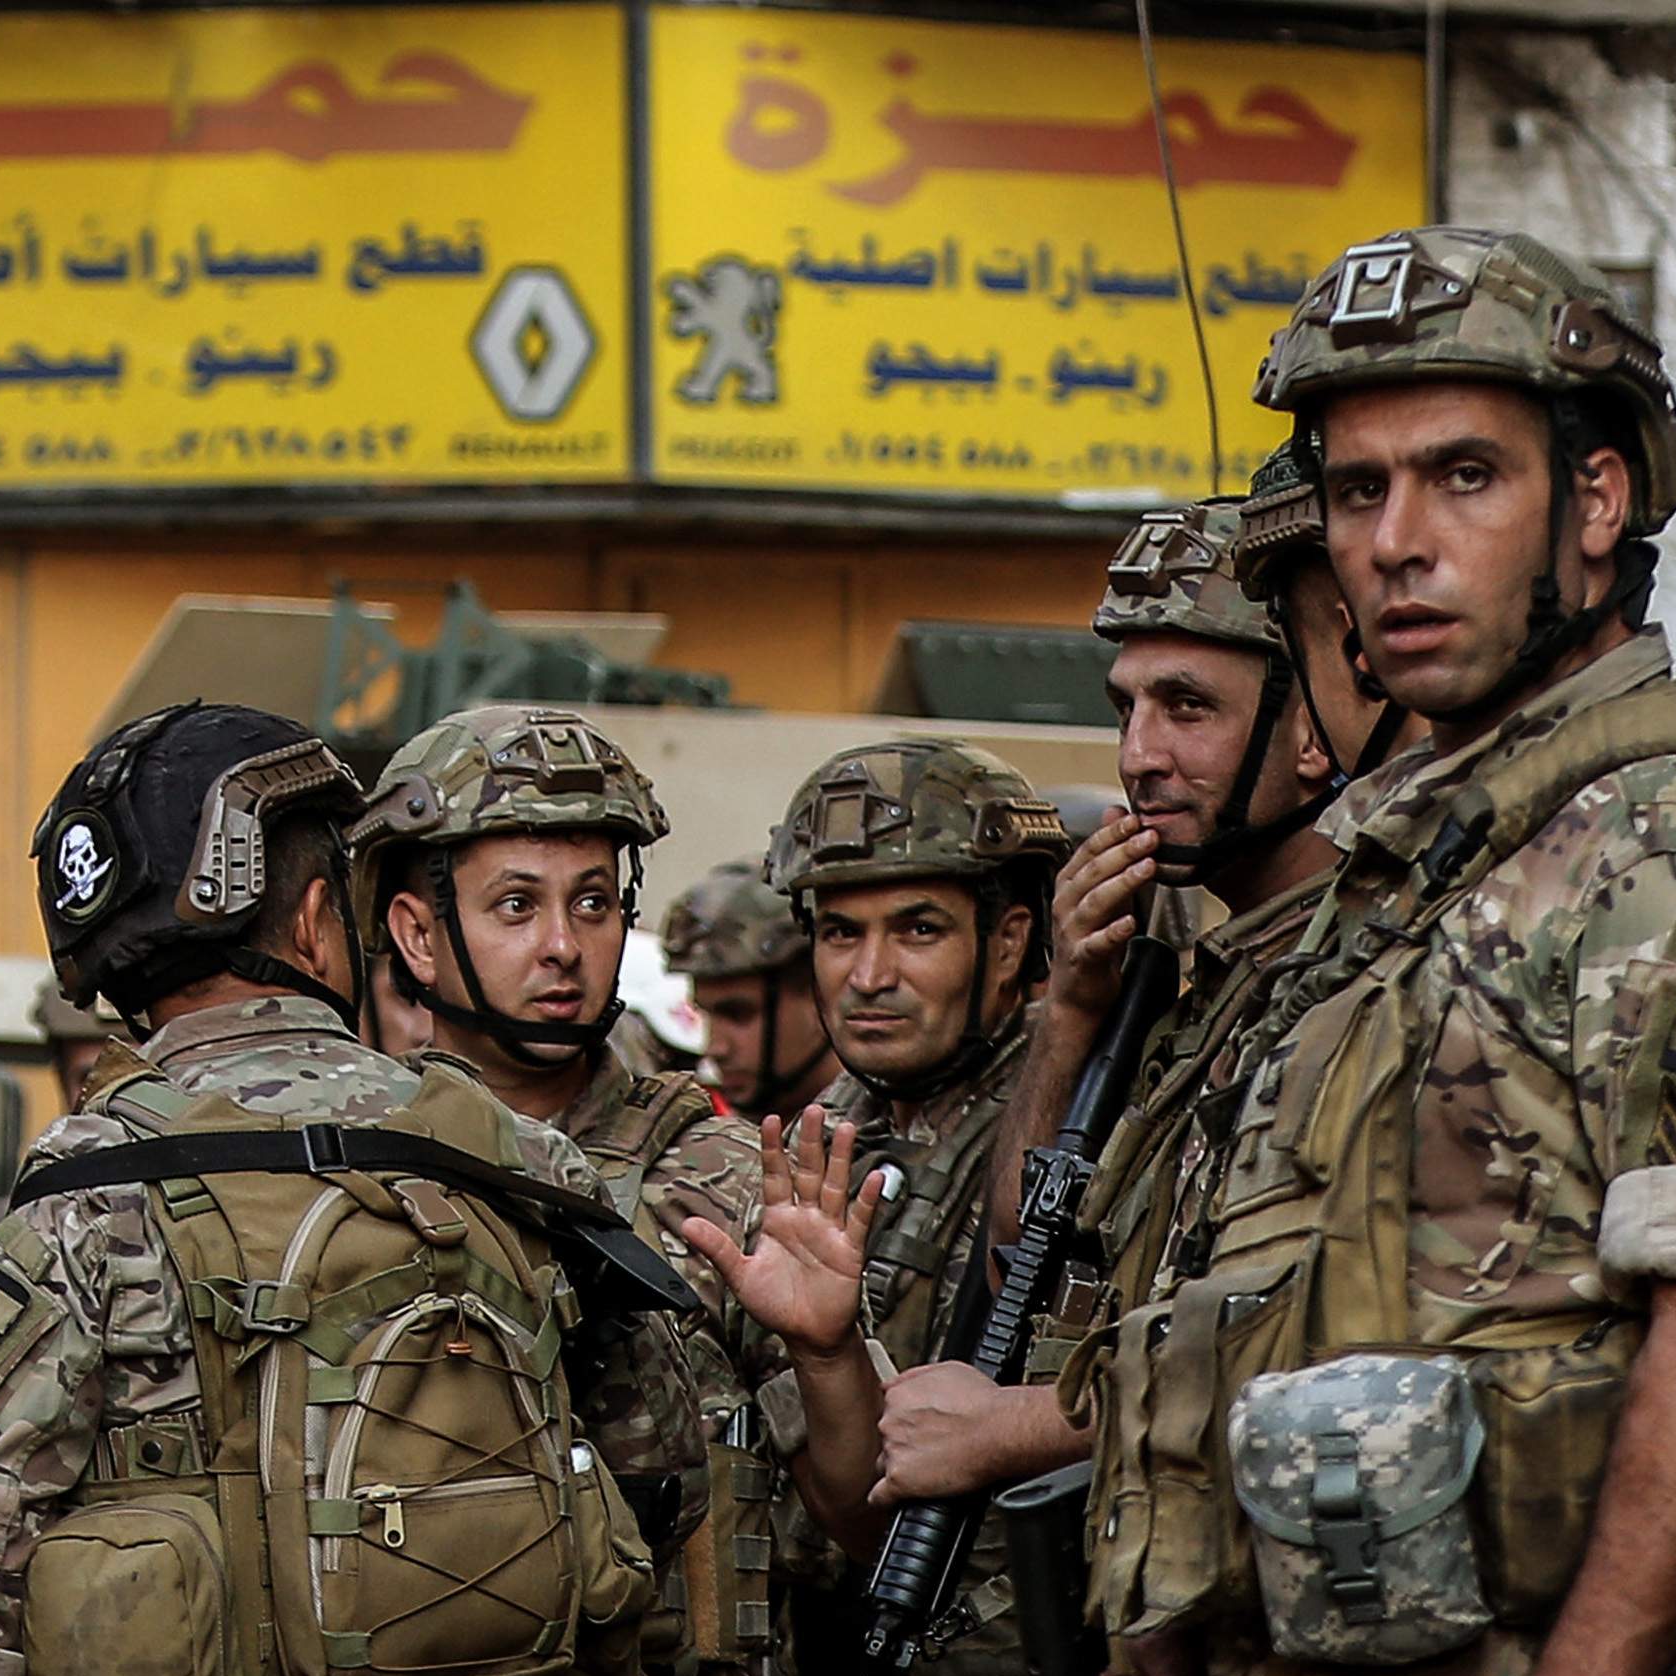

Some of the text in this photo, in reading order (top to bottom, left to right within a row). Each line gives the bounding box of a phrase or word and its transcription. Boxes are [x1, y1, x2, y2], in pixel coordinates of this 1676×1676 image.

[723, 40, 1361, 210] حمزة
[59, 214, 322, 300] سيارات
[346, 217, 485, 293] قطع
[970, 240, 1180, 313] سيارات
[182, 324, 336, 398] رينو
[865, 339, 999, 405] بيجو
[1047, 336, 1168, 410] رينو
